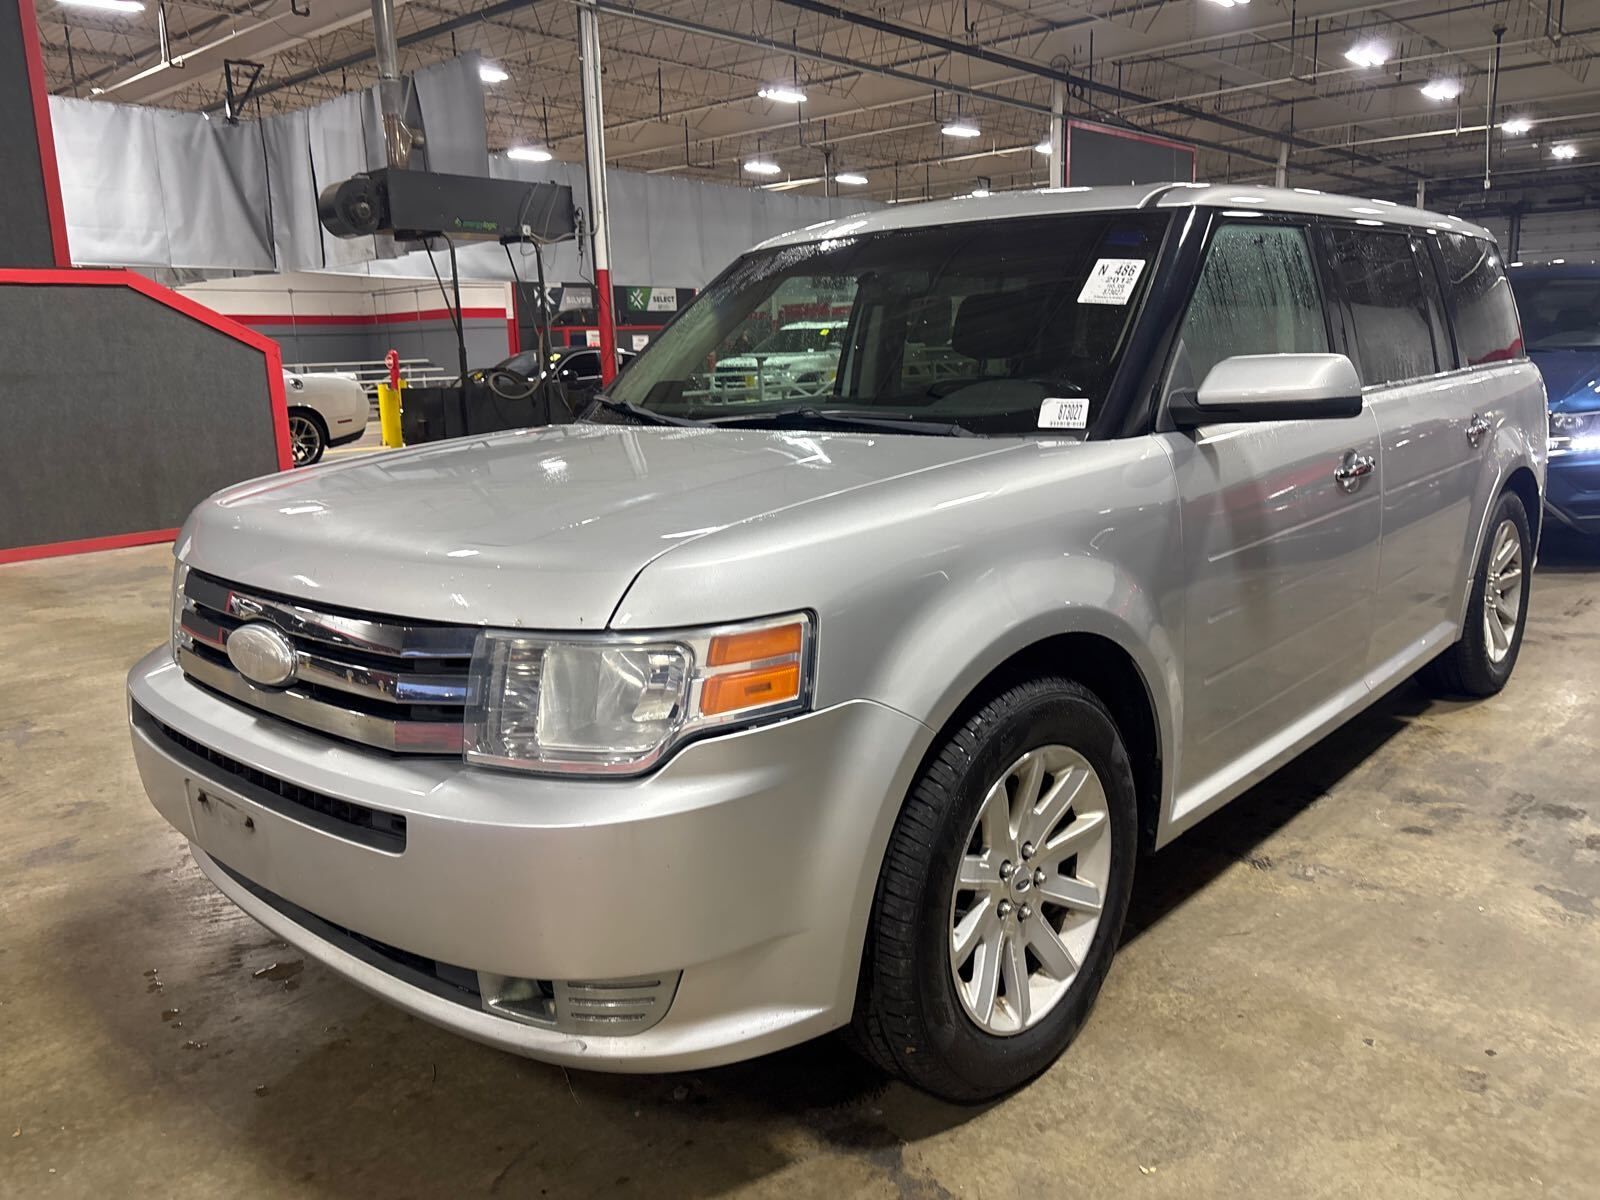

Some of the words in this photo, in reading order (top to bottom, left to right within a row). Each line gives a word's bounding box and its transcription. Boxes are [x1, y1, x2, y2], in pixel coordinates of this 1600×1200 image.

[1098, 264, 1109, 276] N
[1115, 264, 1137, 276] 486
[1105, 276, 1133, 284] 2012
[653, 295, 675, 303] SELECT
